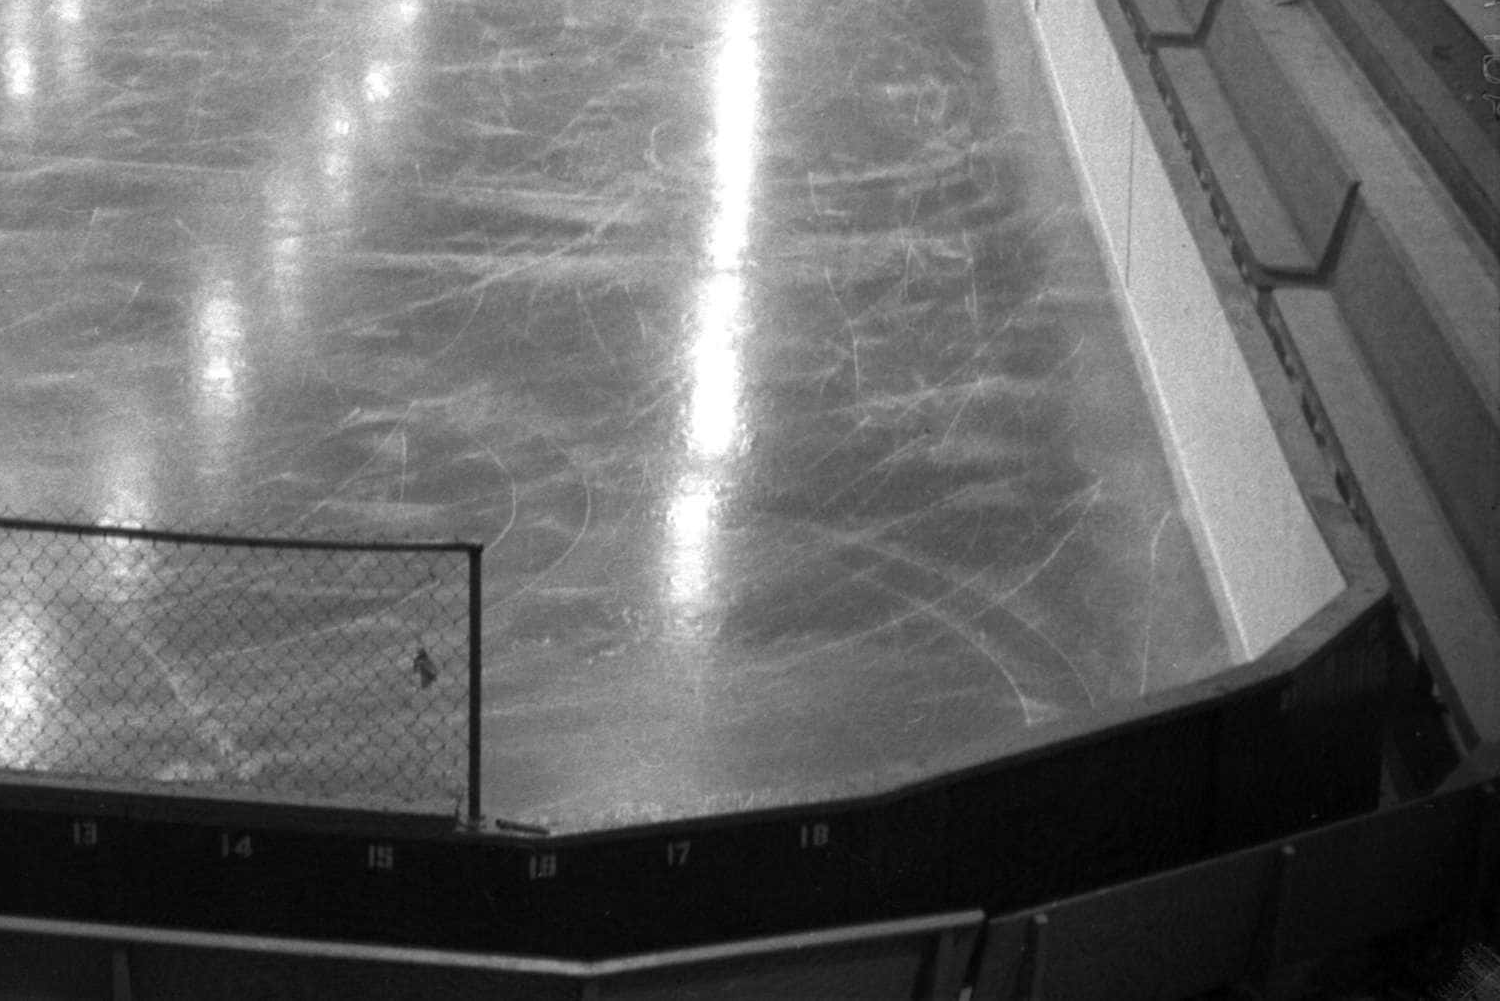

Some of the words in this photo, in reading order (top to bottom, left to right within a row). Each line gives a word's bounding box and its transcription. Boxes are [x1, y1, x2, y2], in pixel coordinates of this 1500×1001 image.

[74, 822, 98, 846] 13
[222, 833, 252, 859] 14
[801, 824, 829, 849] 18
[369, 845, 394, 870] 15
[667, 840, 691, 867] 17
